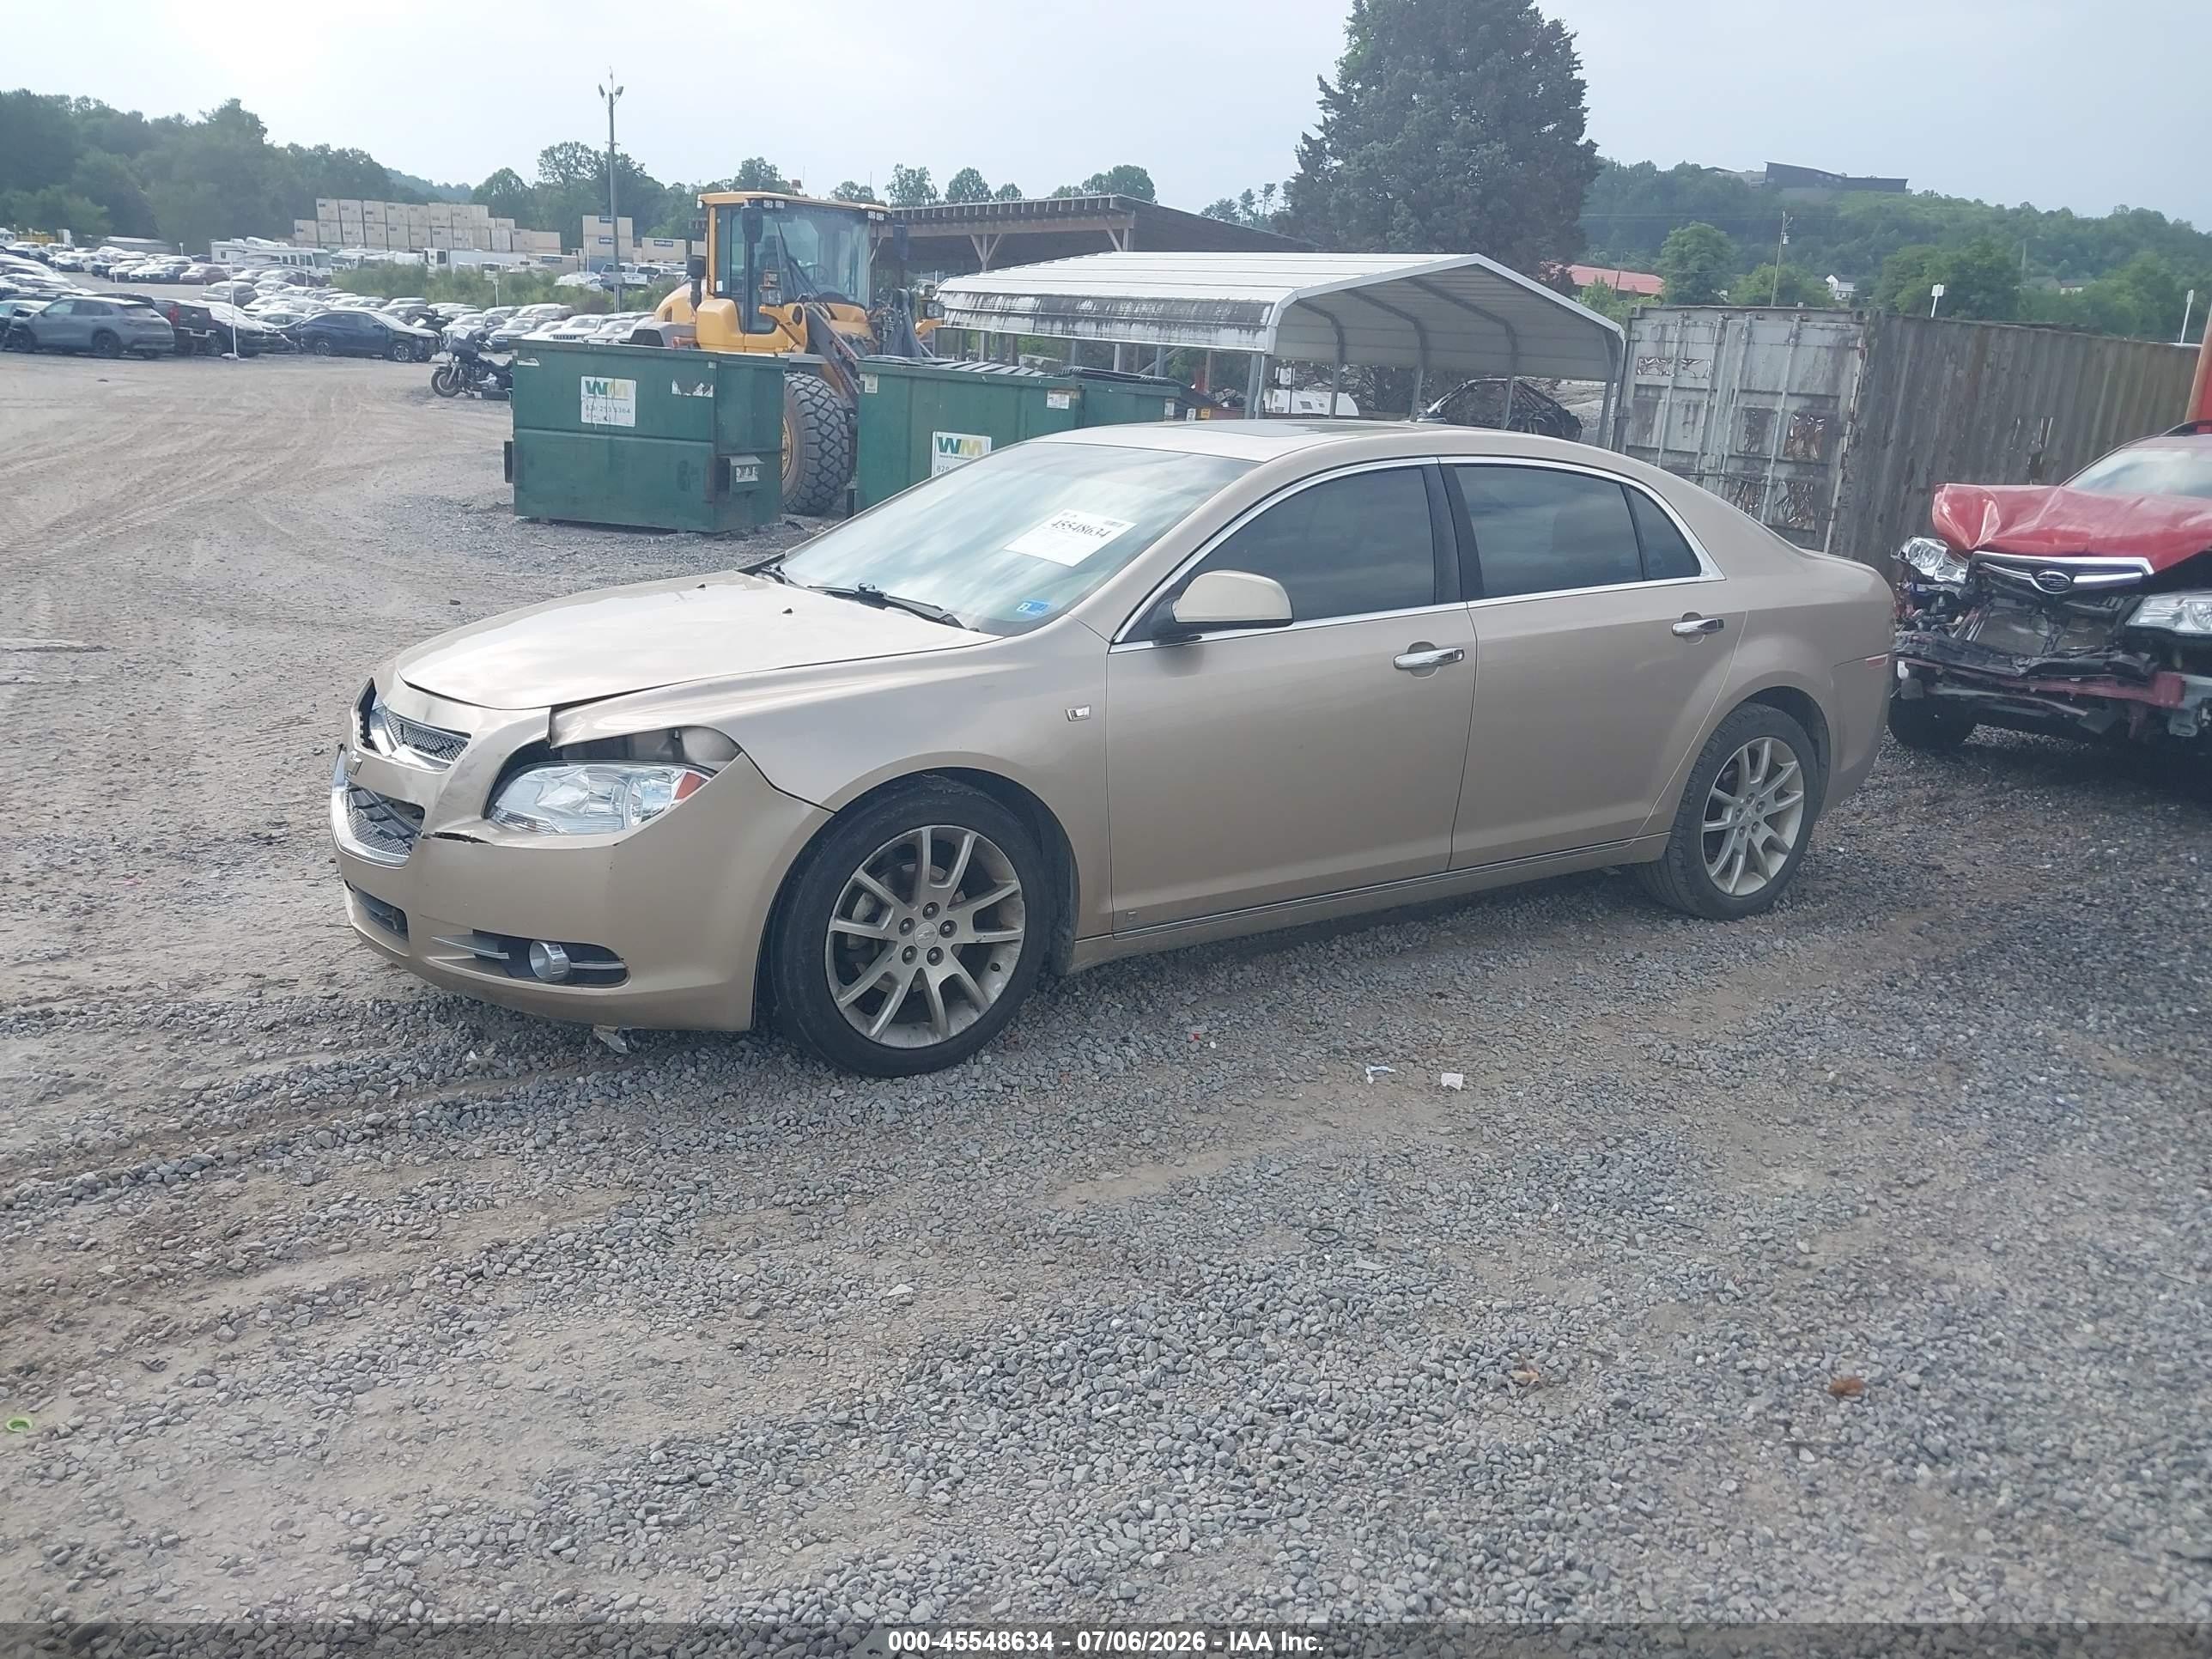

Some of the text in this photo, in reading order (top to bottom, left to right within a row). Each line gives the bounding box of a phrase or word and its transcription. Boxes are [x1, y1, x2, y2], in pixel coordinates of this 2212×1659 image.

[585, 380, 628, 398] WM
[937, 436, 983, 455] WM
[1050, 520, 1112, 538] 45548634
